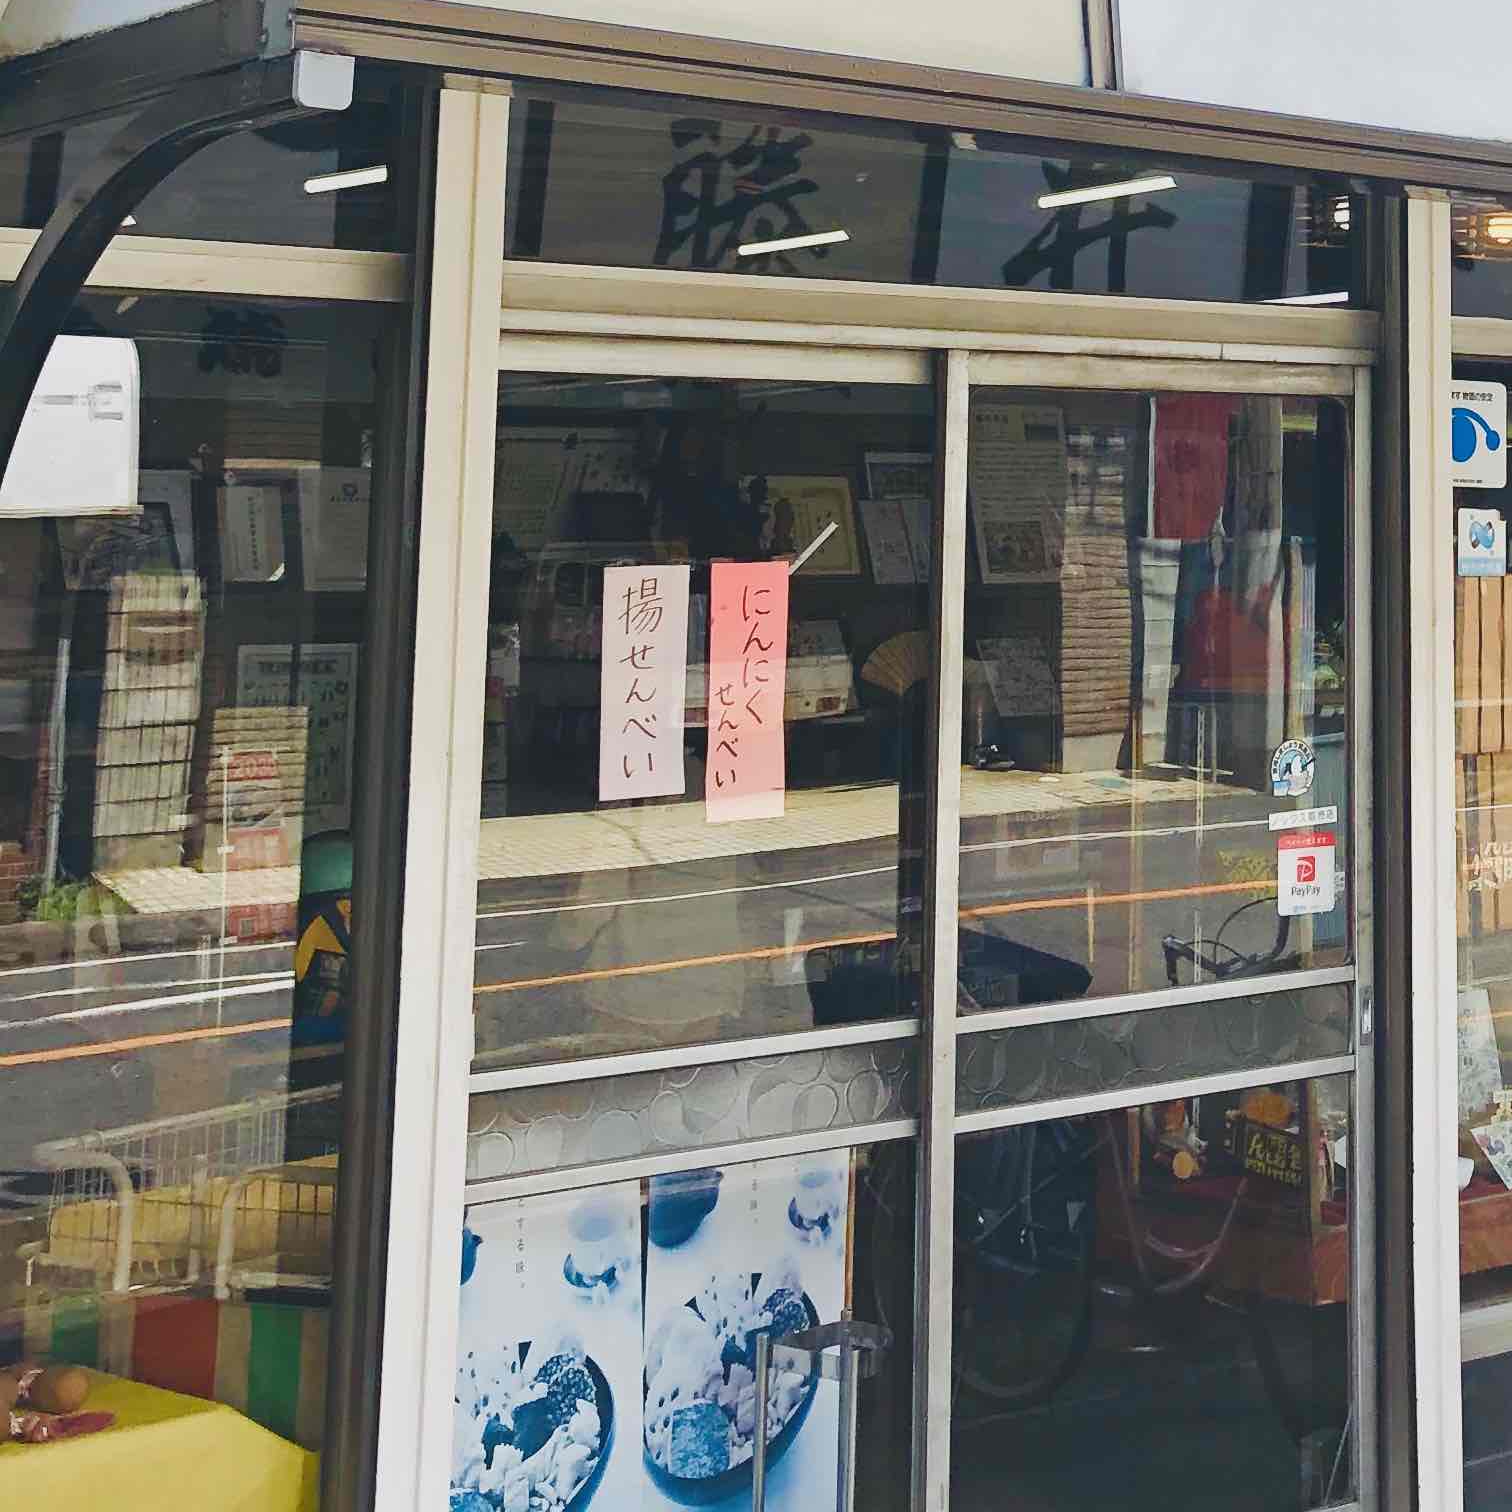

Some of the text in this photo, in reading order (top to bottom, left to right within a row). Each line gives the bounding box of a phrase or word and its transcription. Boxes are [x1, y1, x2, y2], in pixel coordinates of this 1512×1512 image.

[617, 576, 665, 780] 揚せんべい
[742, 583, 774, 726] にんにく
[713, 682, 739, 789] せんべい
[1290, 885, 1321, 897] PayPay
